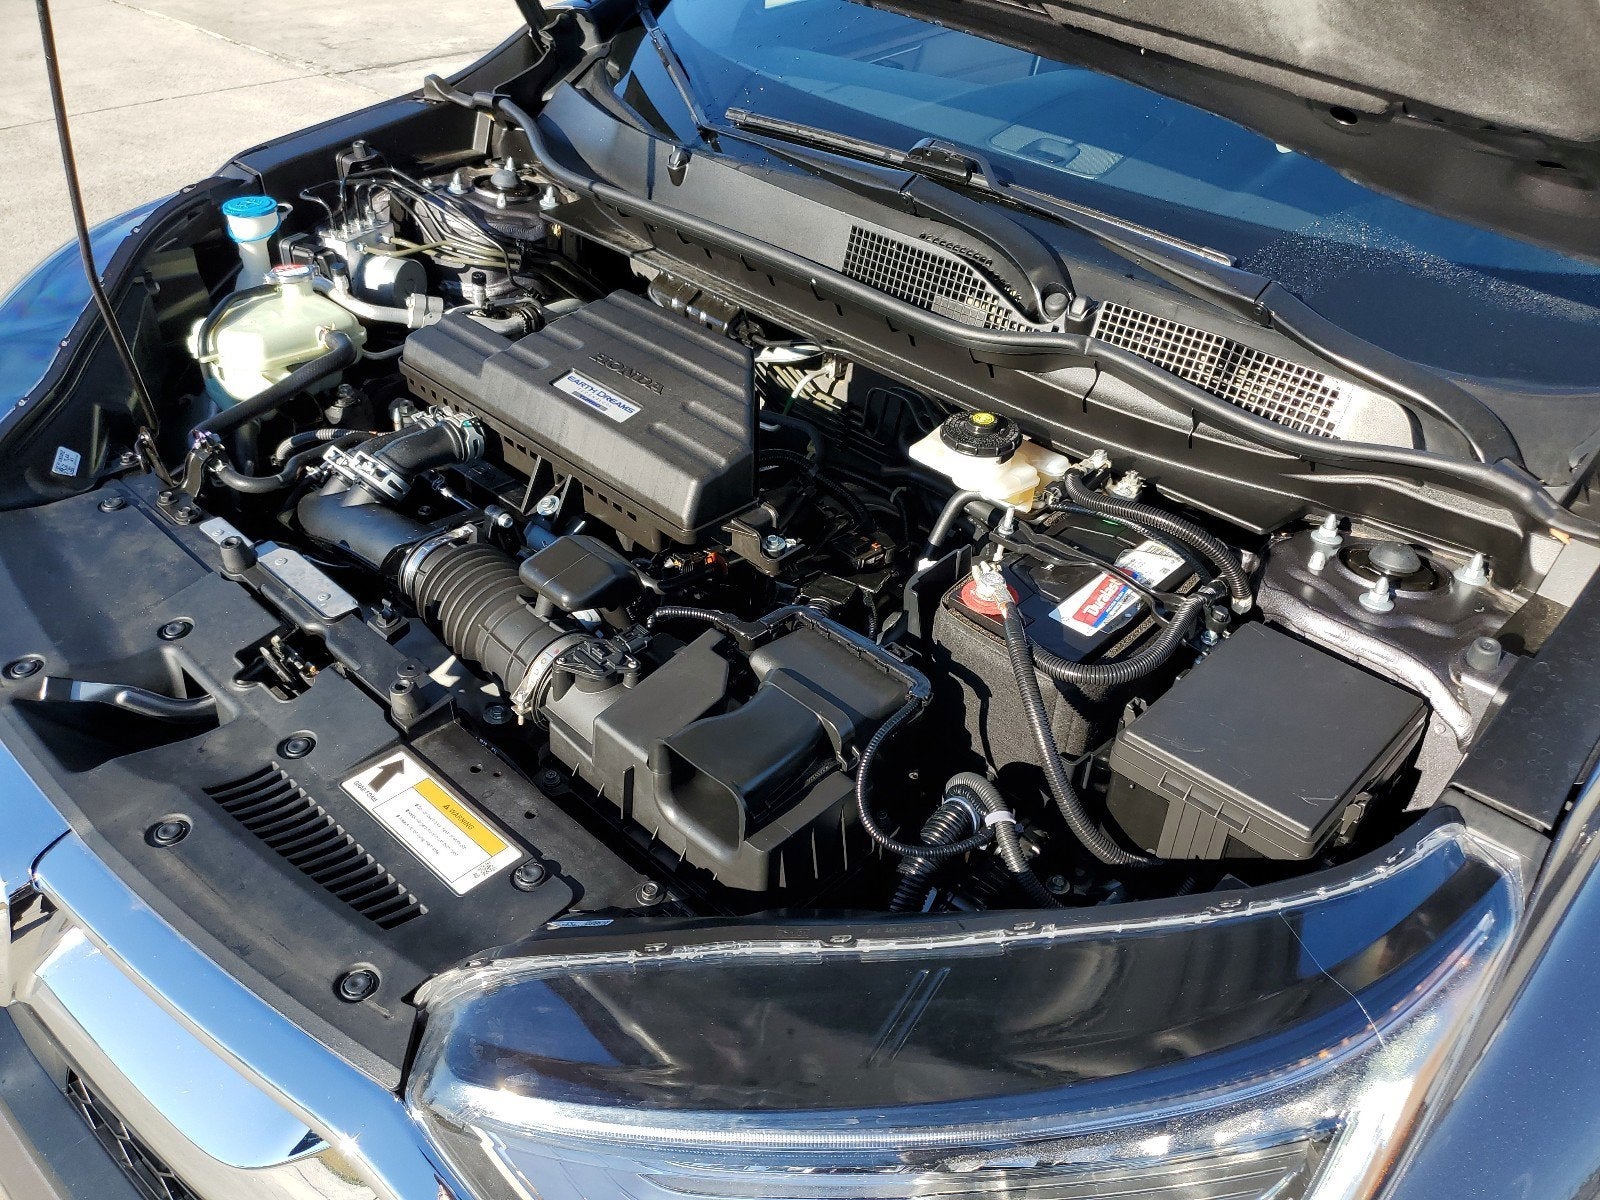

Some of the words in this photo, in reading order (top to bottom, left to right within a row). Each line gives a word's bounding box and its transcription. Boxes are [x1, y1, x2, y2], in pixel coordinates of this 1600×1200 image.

[588, 353, 665, 396] HONDA
[567, 375, 597, 394] EARTH
[597, 390, 636, 414] DREAMS
[449, 808, 475, 831] WARNING
